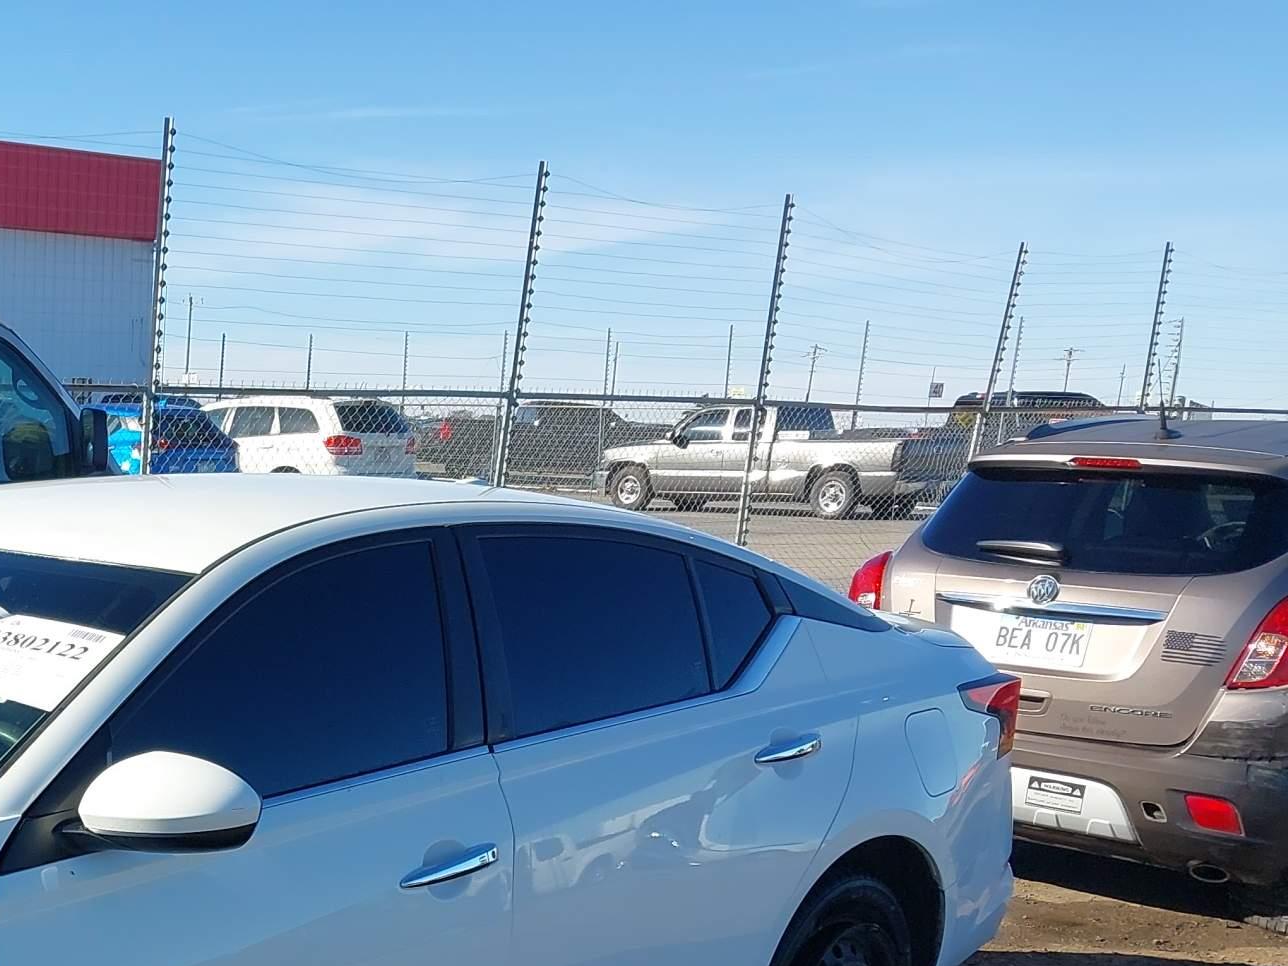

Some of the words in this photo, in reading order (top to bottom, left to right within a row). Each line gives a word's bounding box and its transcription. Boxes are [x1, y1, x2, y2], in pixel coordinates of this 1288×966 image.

[1017, 616, 1070, 631] Arkansas
[995, 626, 1033, 651] BEA
[1045, 631, 1085, 656] 07K
[1089, 704, 1174, 720] ENCORE
